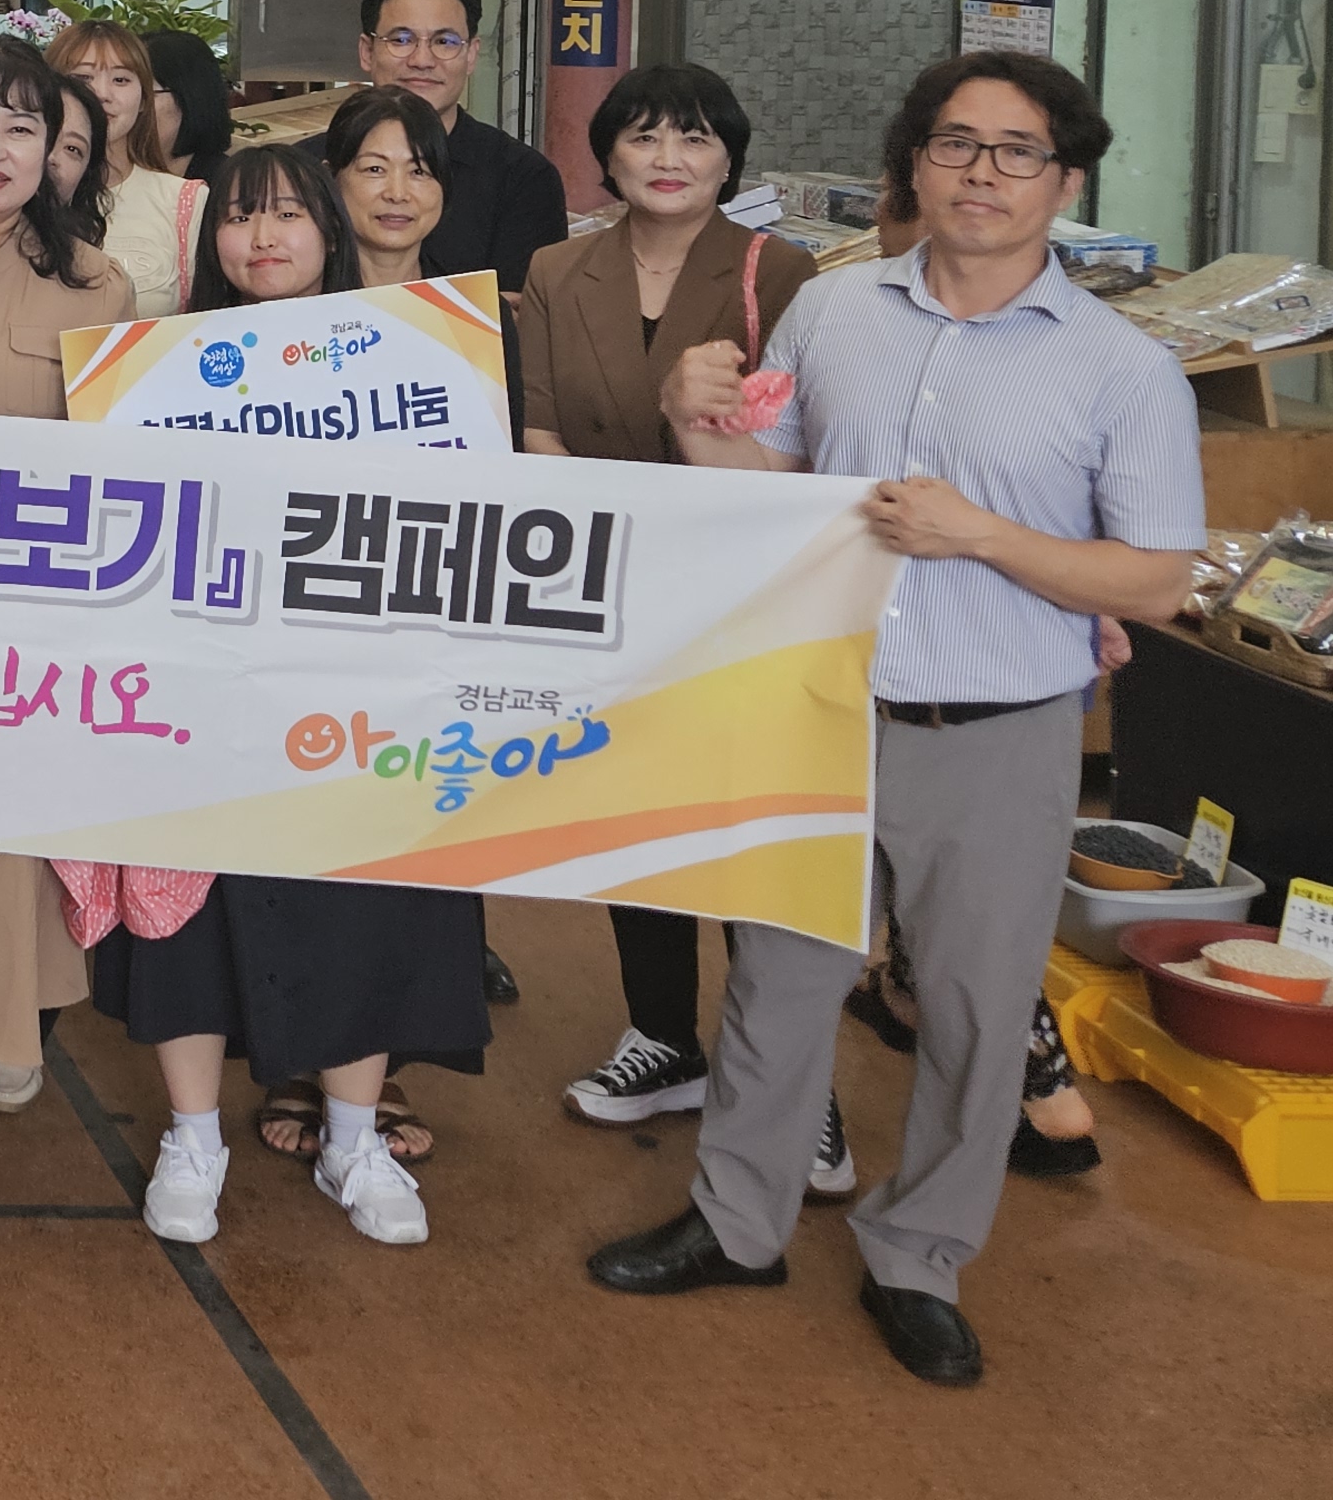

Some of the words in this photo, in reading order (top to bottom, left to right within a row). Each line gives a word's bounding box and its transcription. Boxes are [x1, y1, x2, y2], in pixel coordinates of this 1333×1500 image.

[282, 328, 382, 373] 아이좋아
[330, 320, 364, 334] 경남교육
[370, 381, 451, 433] 나눔
[280, 489, 617, 635] 캠페인
[454, 682, 564, 716] 경남교육
[283, 703, 613, 814] 아이좋아
